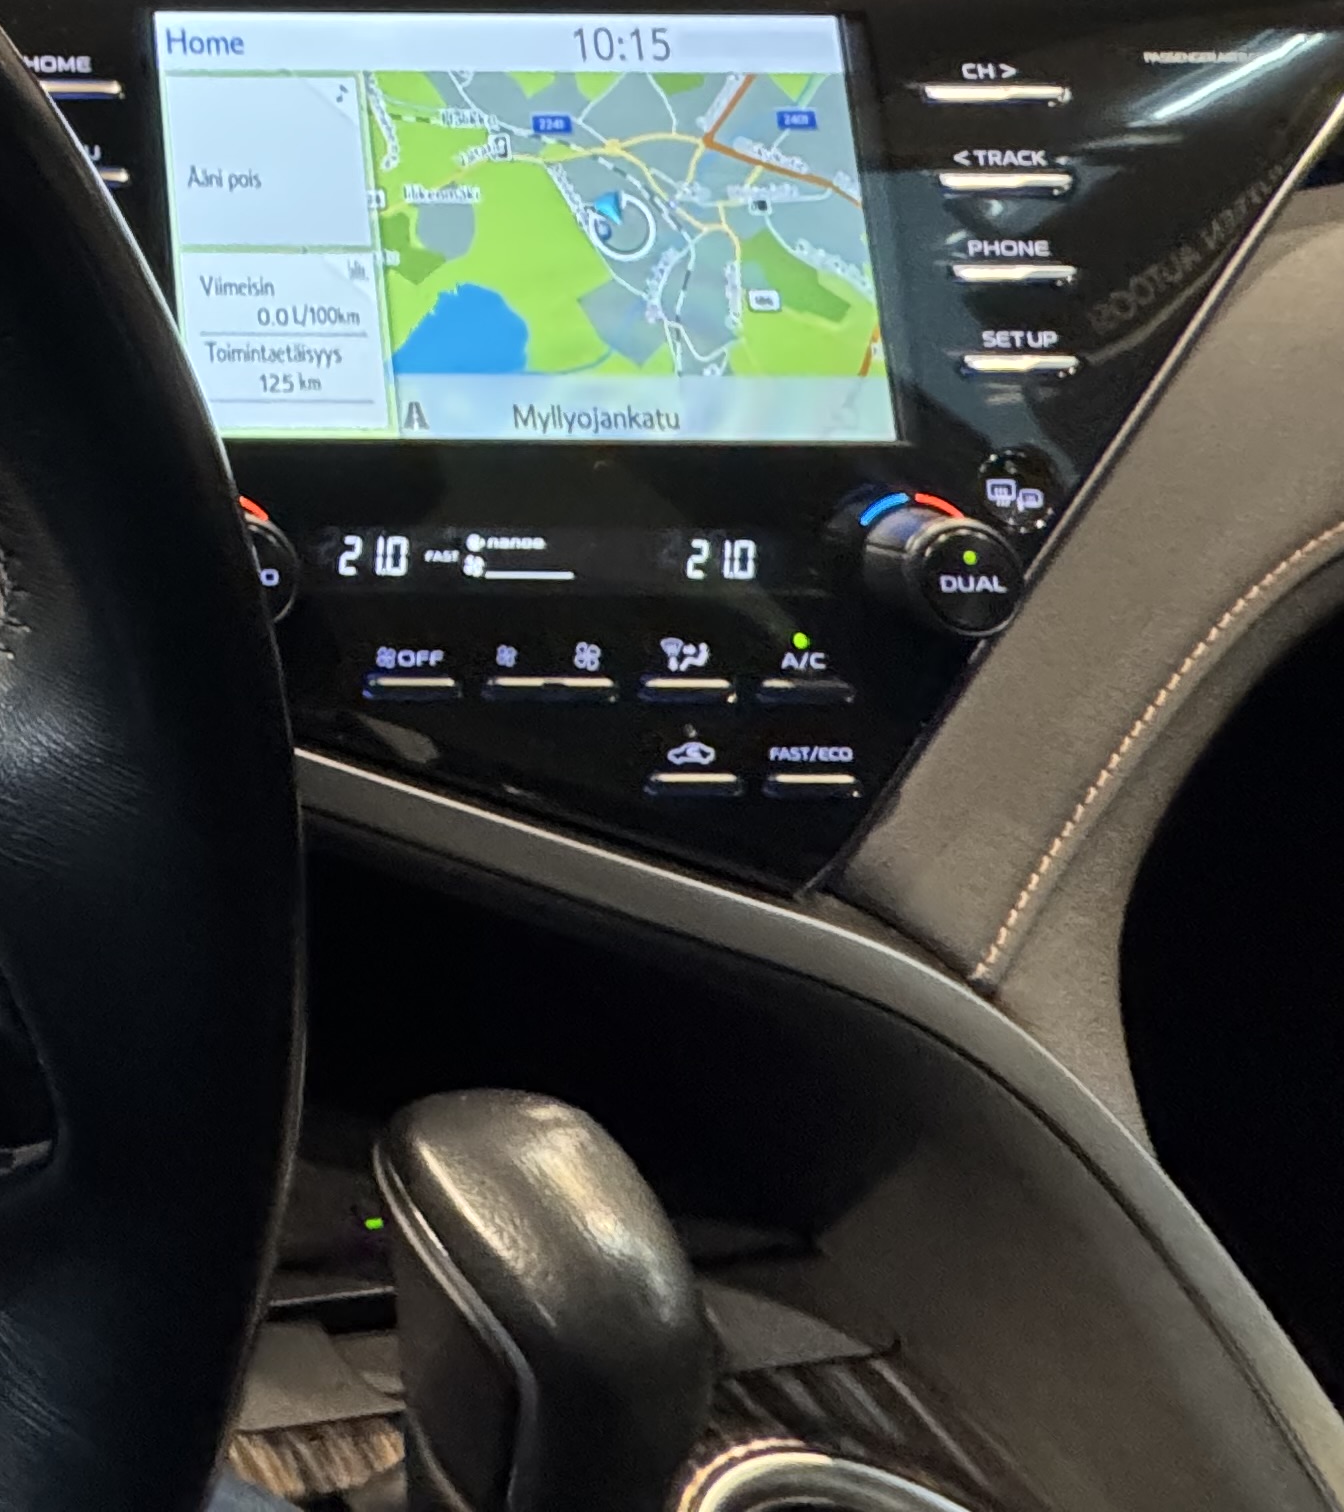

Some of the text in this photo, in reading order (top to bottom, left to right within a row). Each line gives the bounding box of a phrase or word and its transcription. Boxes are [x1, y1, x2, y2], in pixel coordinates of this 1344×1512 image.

[166, 28, 245, 58] Home
[573, 26, 672, 64] 10:15
[23, 54, 93, 74] HOME
[961, 62, 995, 80] CH
[972, 149, 1047, 167] TRACK
[228, 167, 262, 193] pois
[967, 239, 1052, 257] PHONE
[199, 275, 275, 297] Viimeisin
[257, 307, 289, 327] 0.0
[981, 330, 1059, 349] SETUP
[259, 371, 322, 394] 125 km
[513, 403, 681, 434] Myllyojankatu
[423, 549, 460, 564] FAST
[940, 574, 1008, 594] DUAL
[397, 649, 445, 668] OFF
[780, 652, 827, 670] A/C
[769, 745, 854, 762] FAST/ECO
